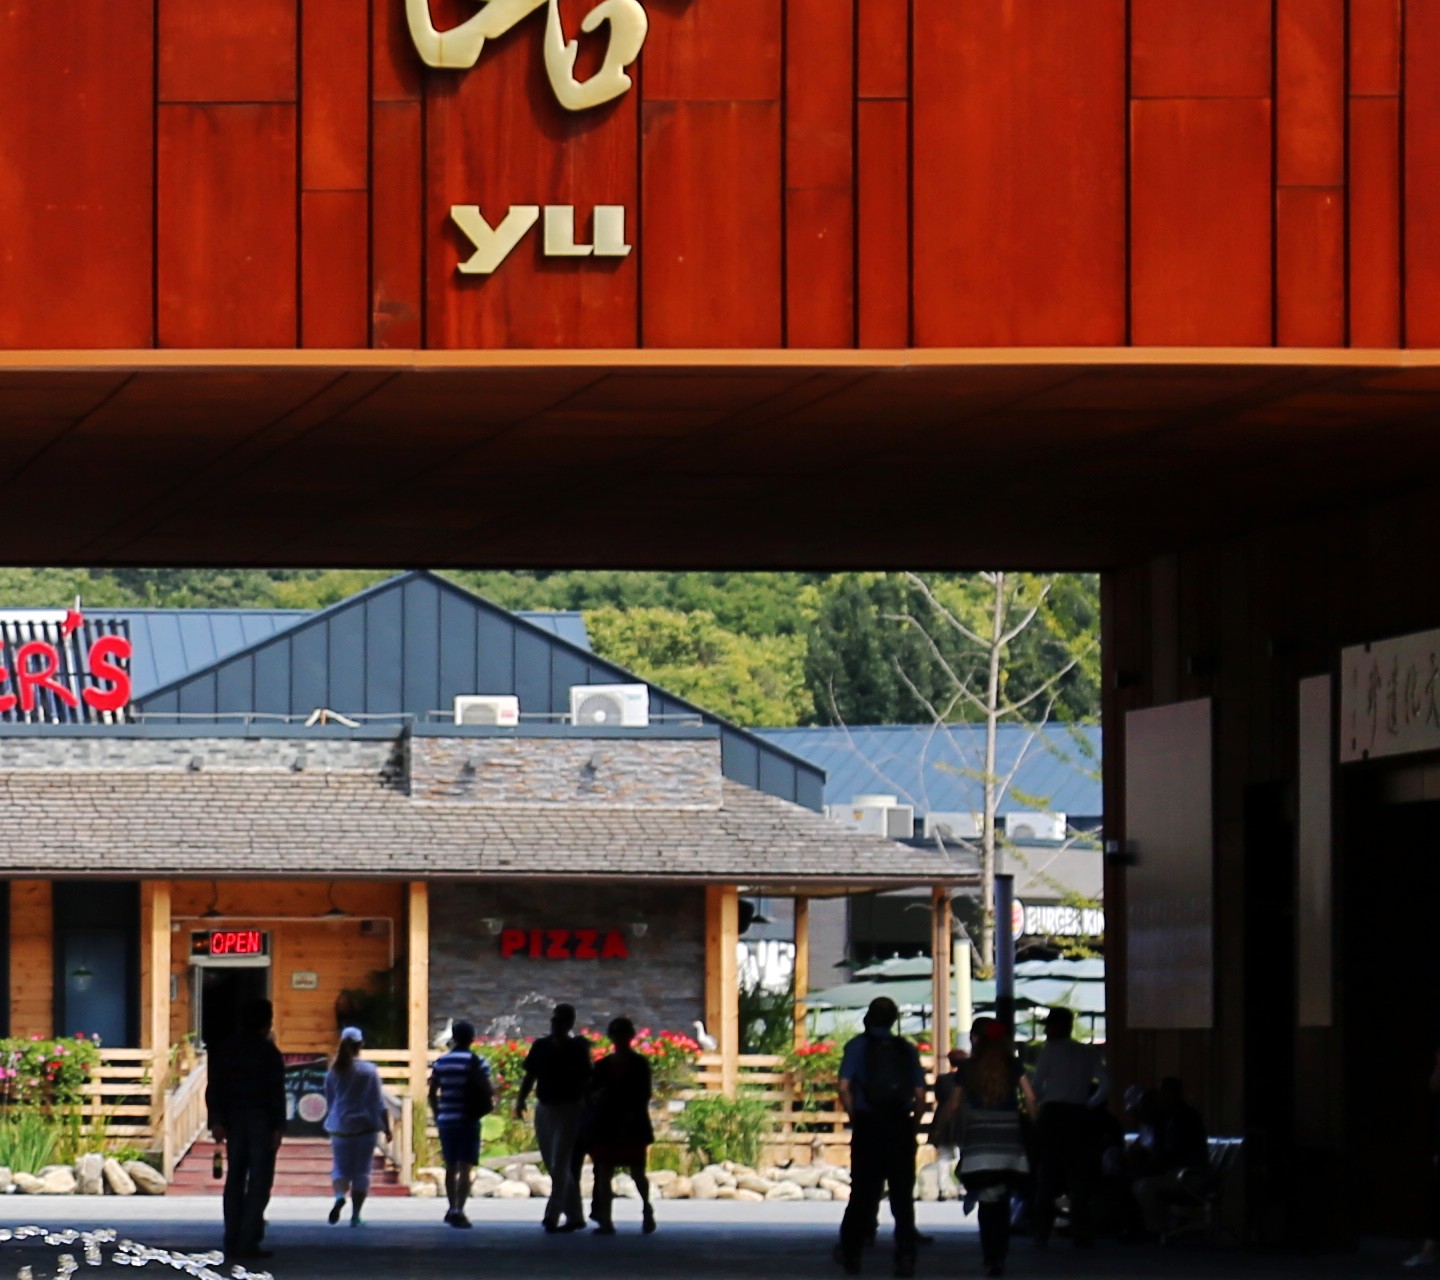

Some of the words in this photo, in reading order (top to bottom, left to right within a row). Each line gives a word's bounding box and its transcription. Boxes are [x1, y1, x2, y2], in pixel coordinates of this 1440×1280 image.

[449, 204, 633, 276] yu
[212, 930, 260, 954] OPEN
[500, 928, 628, 960] PIZZA
